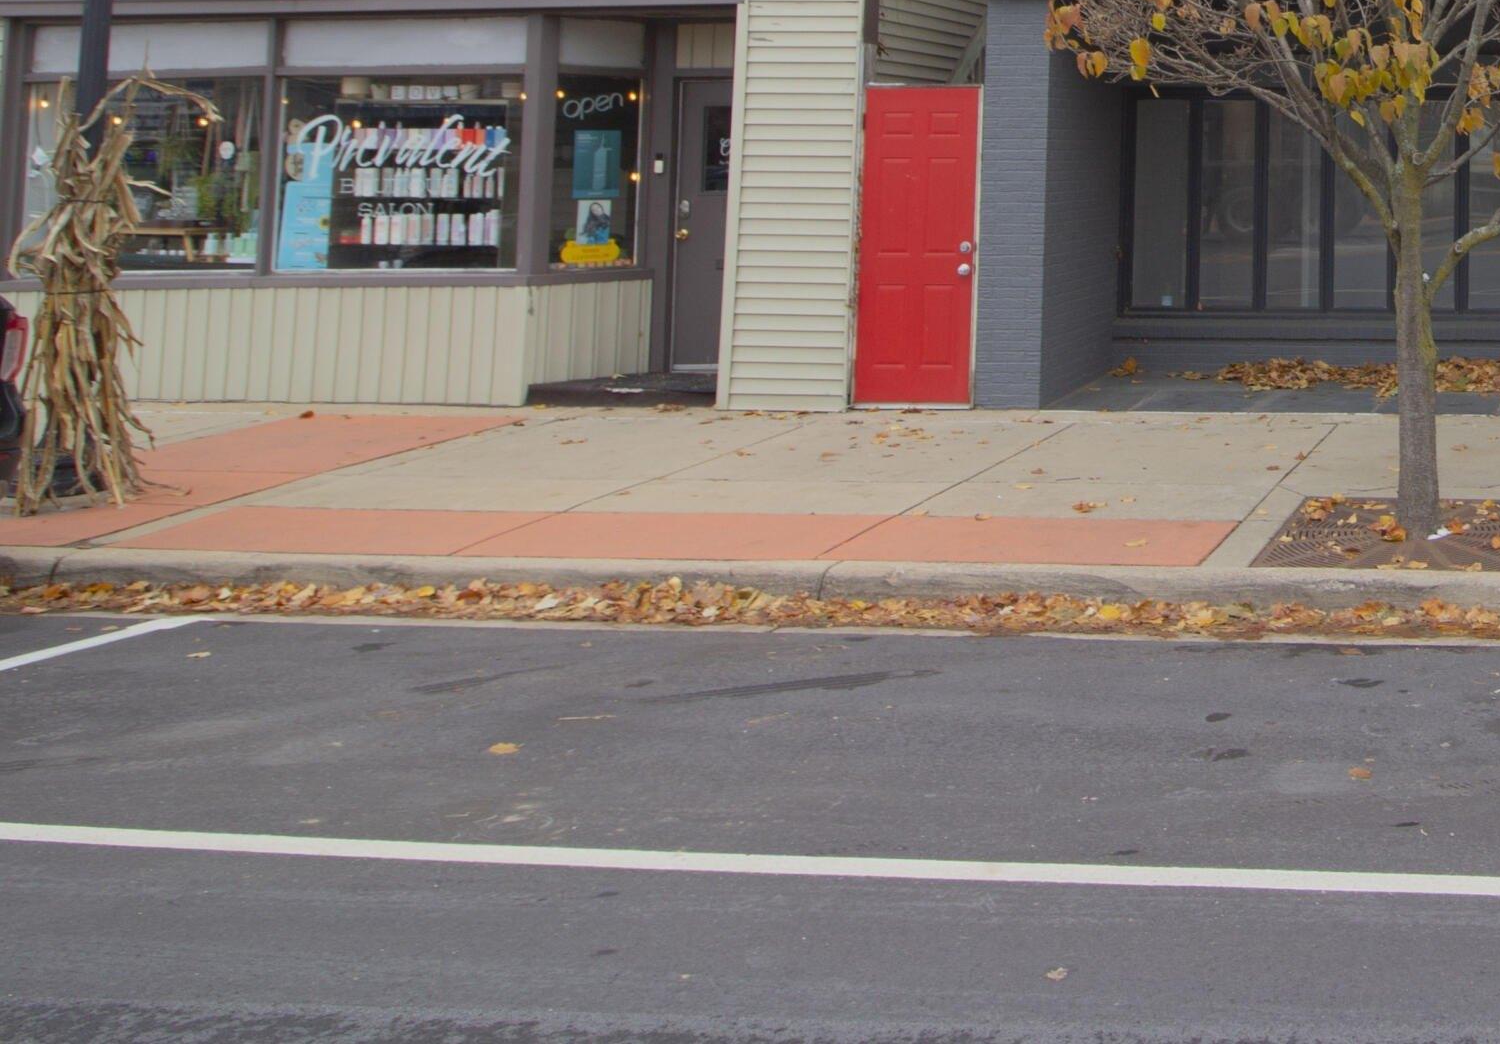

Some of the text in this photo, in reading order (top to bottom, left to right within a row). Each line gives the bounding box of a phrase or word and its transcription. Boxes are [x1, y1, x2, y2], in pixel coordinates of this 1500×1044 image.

[563, 92, 623, 121] open
[297, 114, 512, 180] Prevalent
[357, 202, 435, 218] SALON
